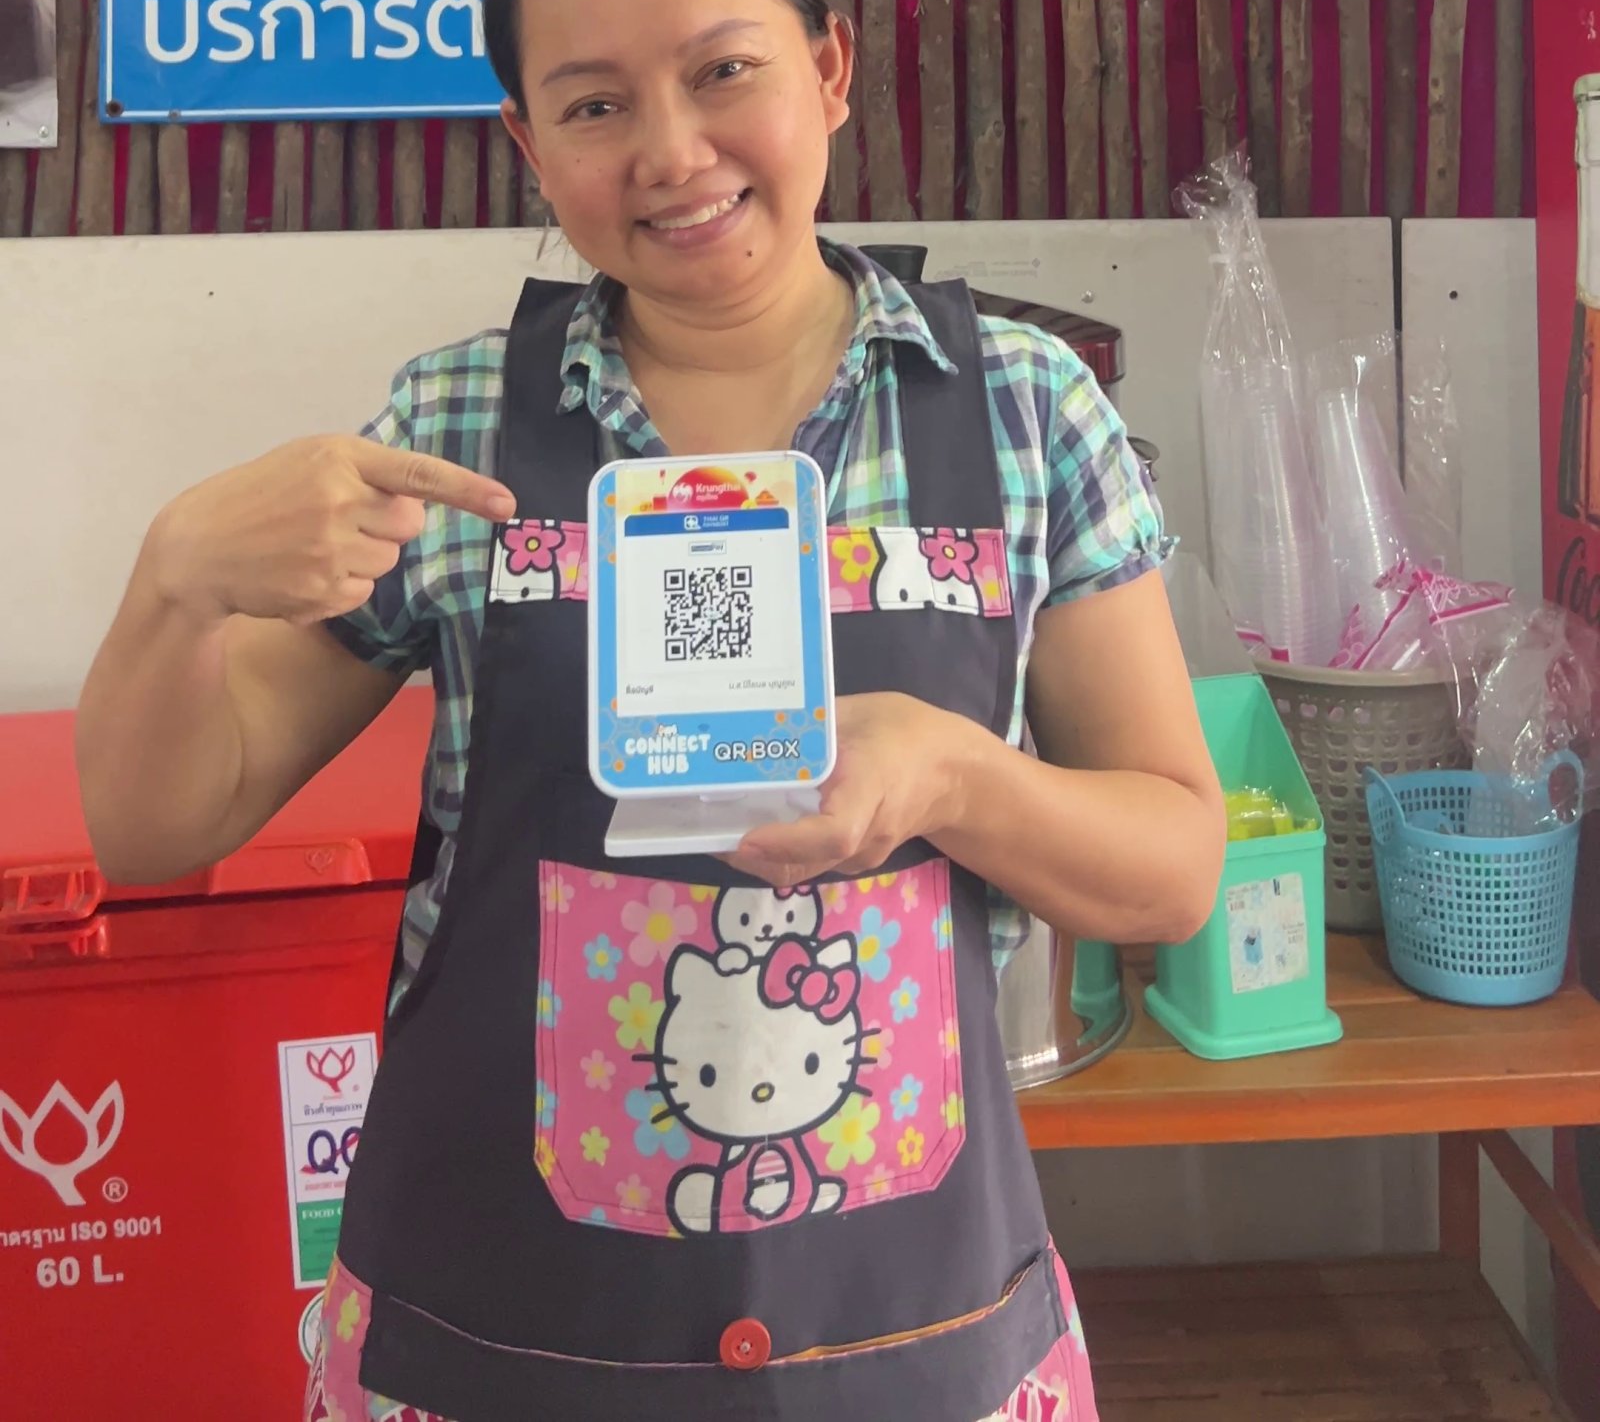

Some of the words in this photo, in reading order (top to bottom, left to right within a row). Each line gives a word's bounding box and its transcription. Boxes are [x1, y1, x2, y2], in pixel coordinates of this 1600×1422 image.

[625, 733, 711, 755] CONNECT
[714, 742, 746, 761] QR
[752, 739, 800, 759] BOX
[648, 754, 690, 776] HUB
[71, 1220, 107, 1242] ISO
[113, 1215, 162, 1238] 9001
[36, 1256, 80, 1288] 60
